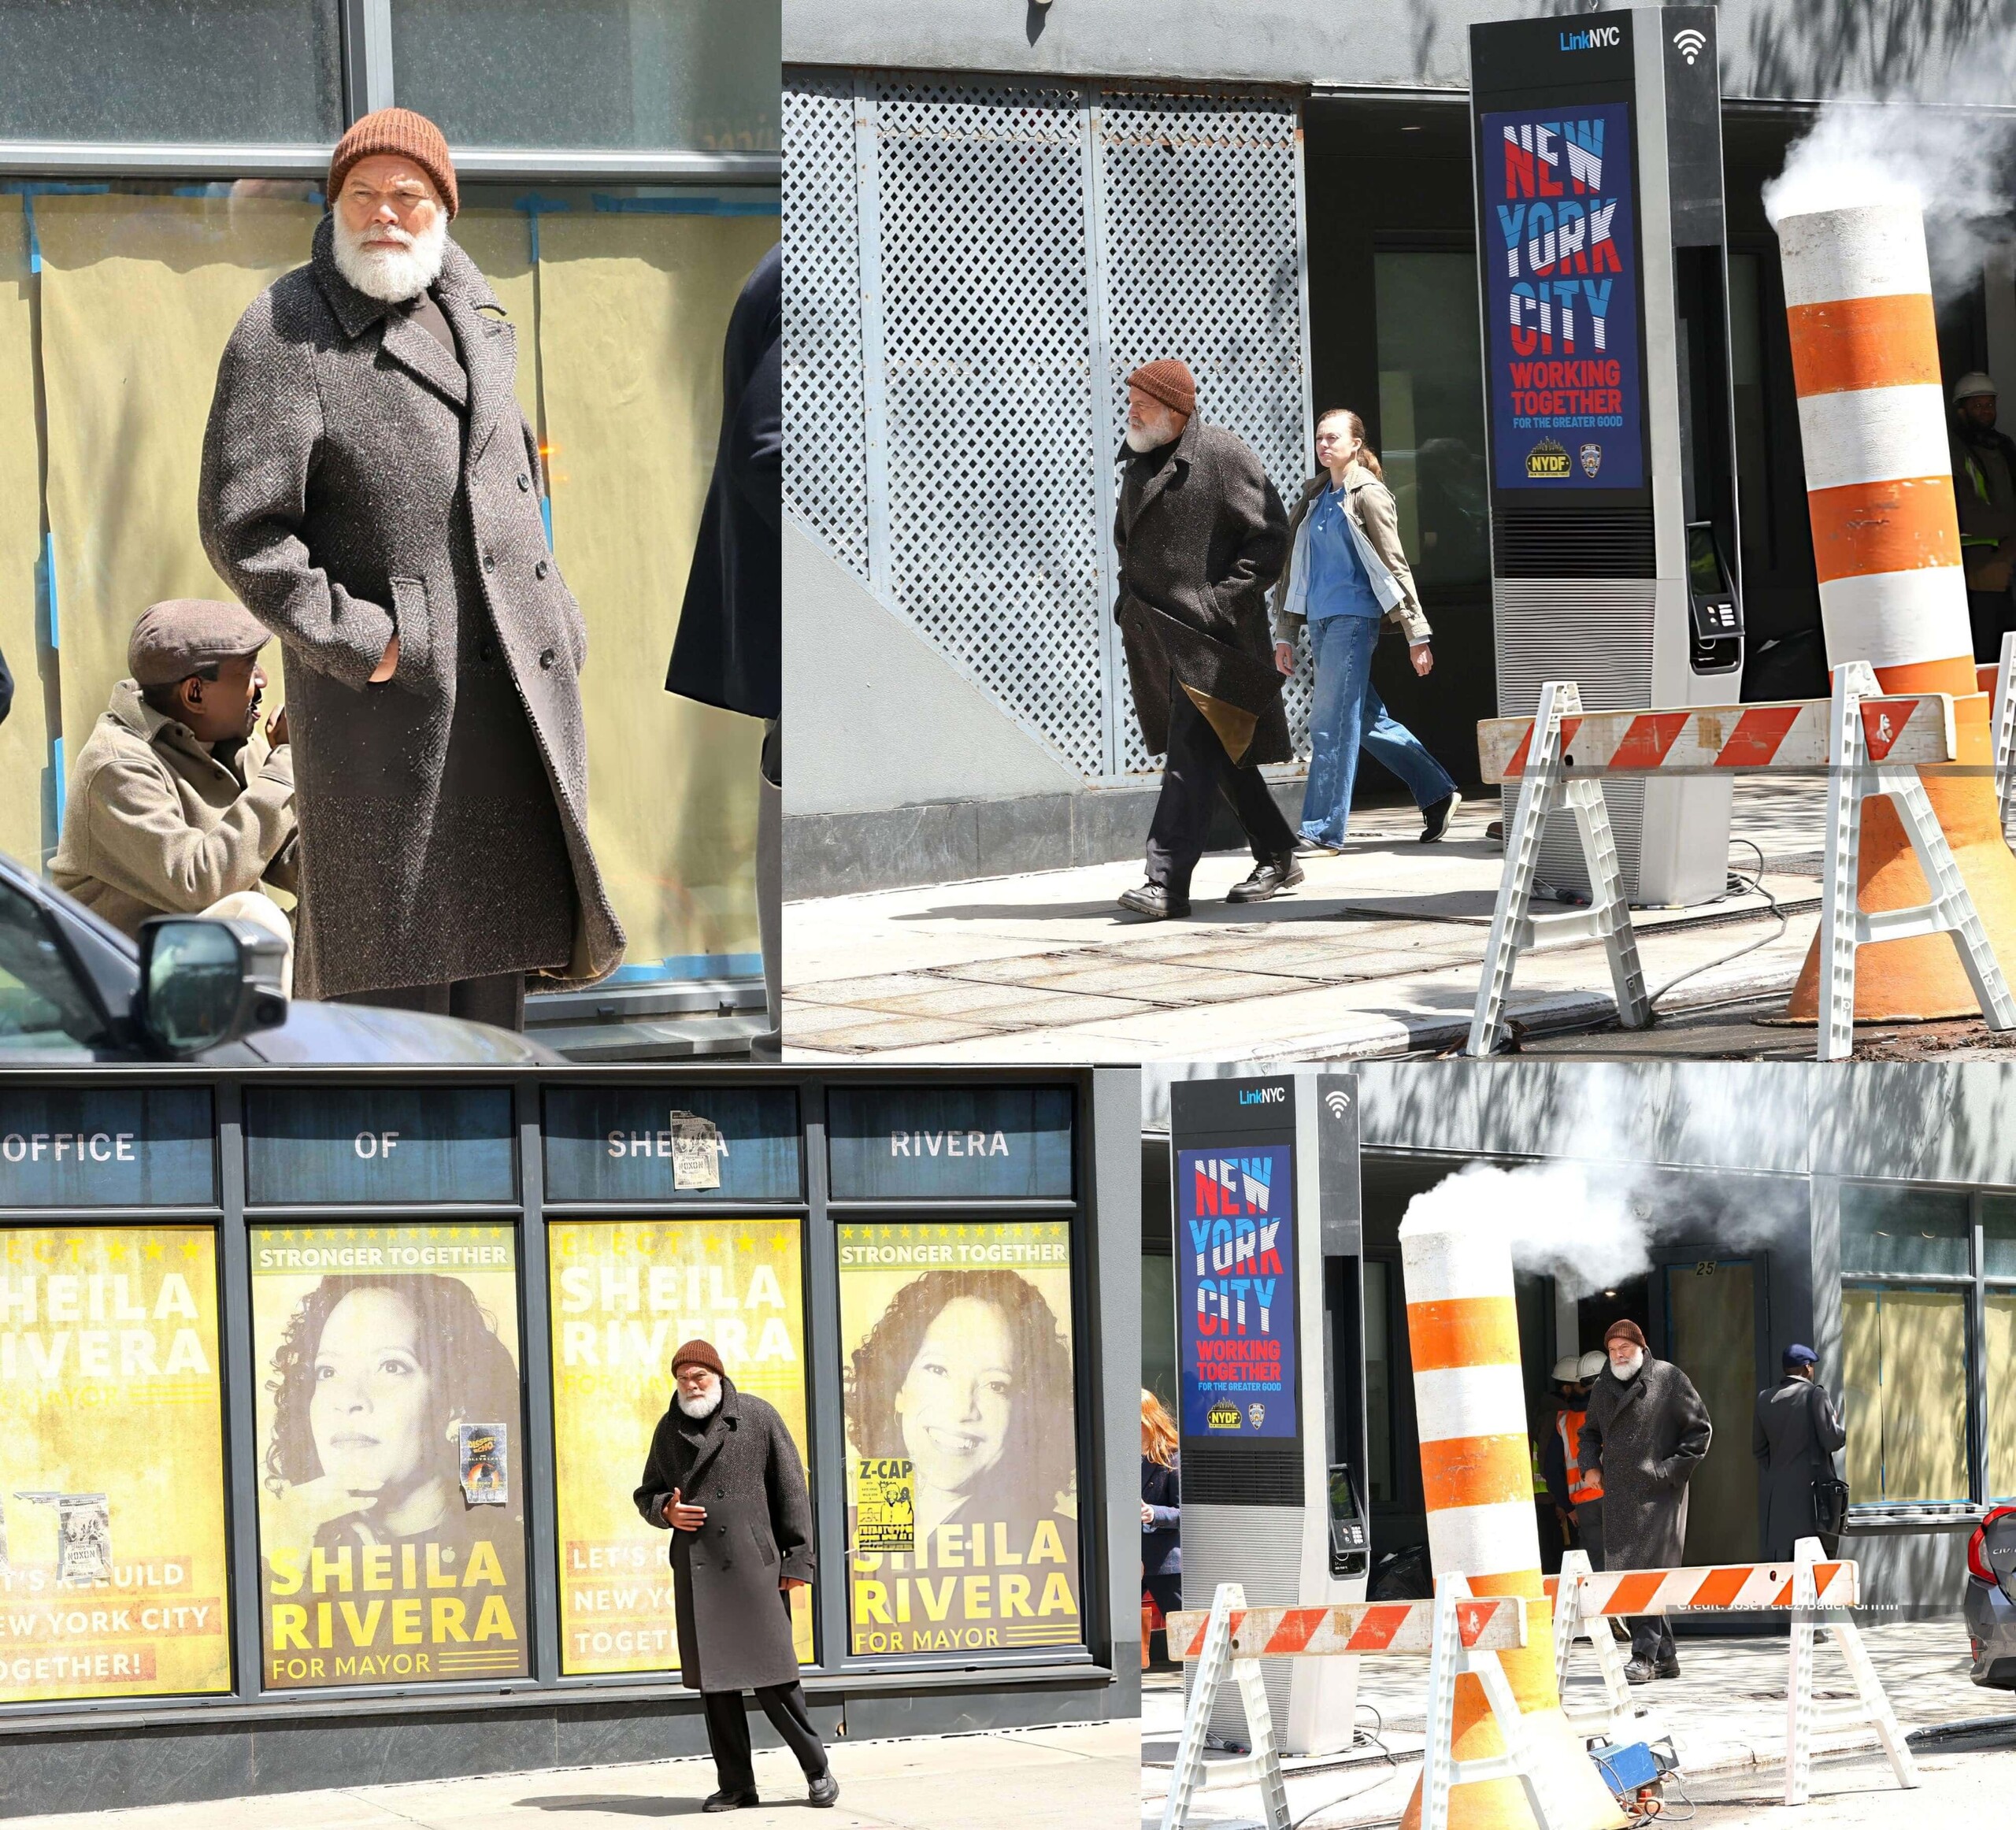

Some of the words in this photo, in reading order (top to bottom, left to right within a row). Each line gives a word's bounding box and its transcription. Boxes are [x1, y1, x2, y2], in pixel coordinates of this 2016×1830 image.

[1560, 27, 1620, 51] LinkNYC
[1503, 119, 1606, 198] NEW
[1496, 198, 1622, 278] YORK
[1509, 279, 1613, 357] CITY
[1510, 359, 1621, 389] WORKING
[1511, 389, 1622, 415] TOGETHER
[1513, 417, 1531, 428] FOR
[1534, 417, 1551, 428] THE
[1553, 417, 1595, 428] GREATER
[1597, 416, 1622, 427] GOOD
[1532, 457, 1566, 472] NYDF
[1240, 1087, 1285, 1105] LinkNYC
[3, 1132, 135, 1162] OFFICE
[354, 1131, 400, 1159] OF
[607, 1130, 729, 1158] SHEA
[891, 1130, 1010, 1158] RIVERA
[1195, 1157, 1273, 1216] NEW
[259, 1246, 384, 1267] STRONGER
[388, 1244, 507, 1265] TOGETHER
[561, 1231, 683, 1257] ELECT
[841, 1245, 954, 1264] STRONGER
[957, 1243, 1067, 1262] TOGETHER
[1188, 1217, 1283, 1276] YORK
[1696, 1261, 1715, 1276] 25
[560, 1265, 786, 1313] SHEILA
[1197, 1278, 1276, 1336] CITY
[562, 1317, 798, 1367] RIVERA
[1196, 1339, 1281, 1361] WORKING
[1197, 1361, 1281, 1381] TOGETHER
[1199, 1382, 1213, 1391] FOR
[1214, 1382, 1227, 1391] THE
[1228, 1382, 1261, 1391] GREATER
[1262, 1382, 1281, 1391] GOOD
[1211, 1412, 1238, 1424] NYDF
[860, 1460, 913, 1479] Z-CAP
[270, 1540, 506, 1596] SHEILA
[573, 1546, 646, 1569] LET'S
[574, 1587, 639, 1612] NEW
[854, 1573, 1077, 1625] RIVERA
[46, 1610, 132, 1635] YORK
[141, 1605, 209, 1631] CITY
[272, 1595, 517, 1651] RIVERA
[574, 1628, 676, 1654] TOGET
[855, 1632, 903, 1653] FOR
[914, 1627, 999, 1650] MAYOR
[272, 1658, 324, 1680] FOR
[335, 1652, 430, 1676] MAYOR
